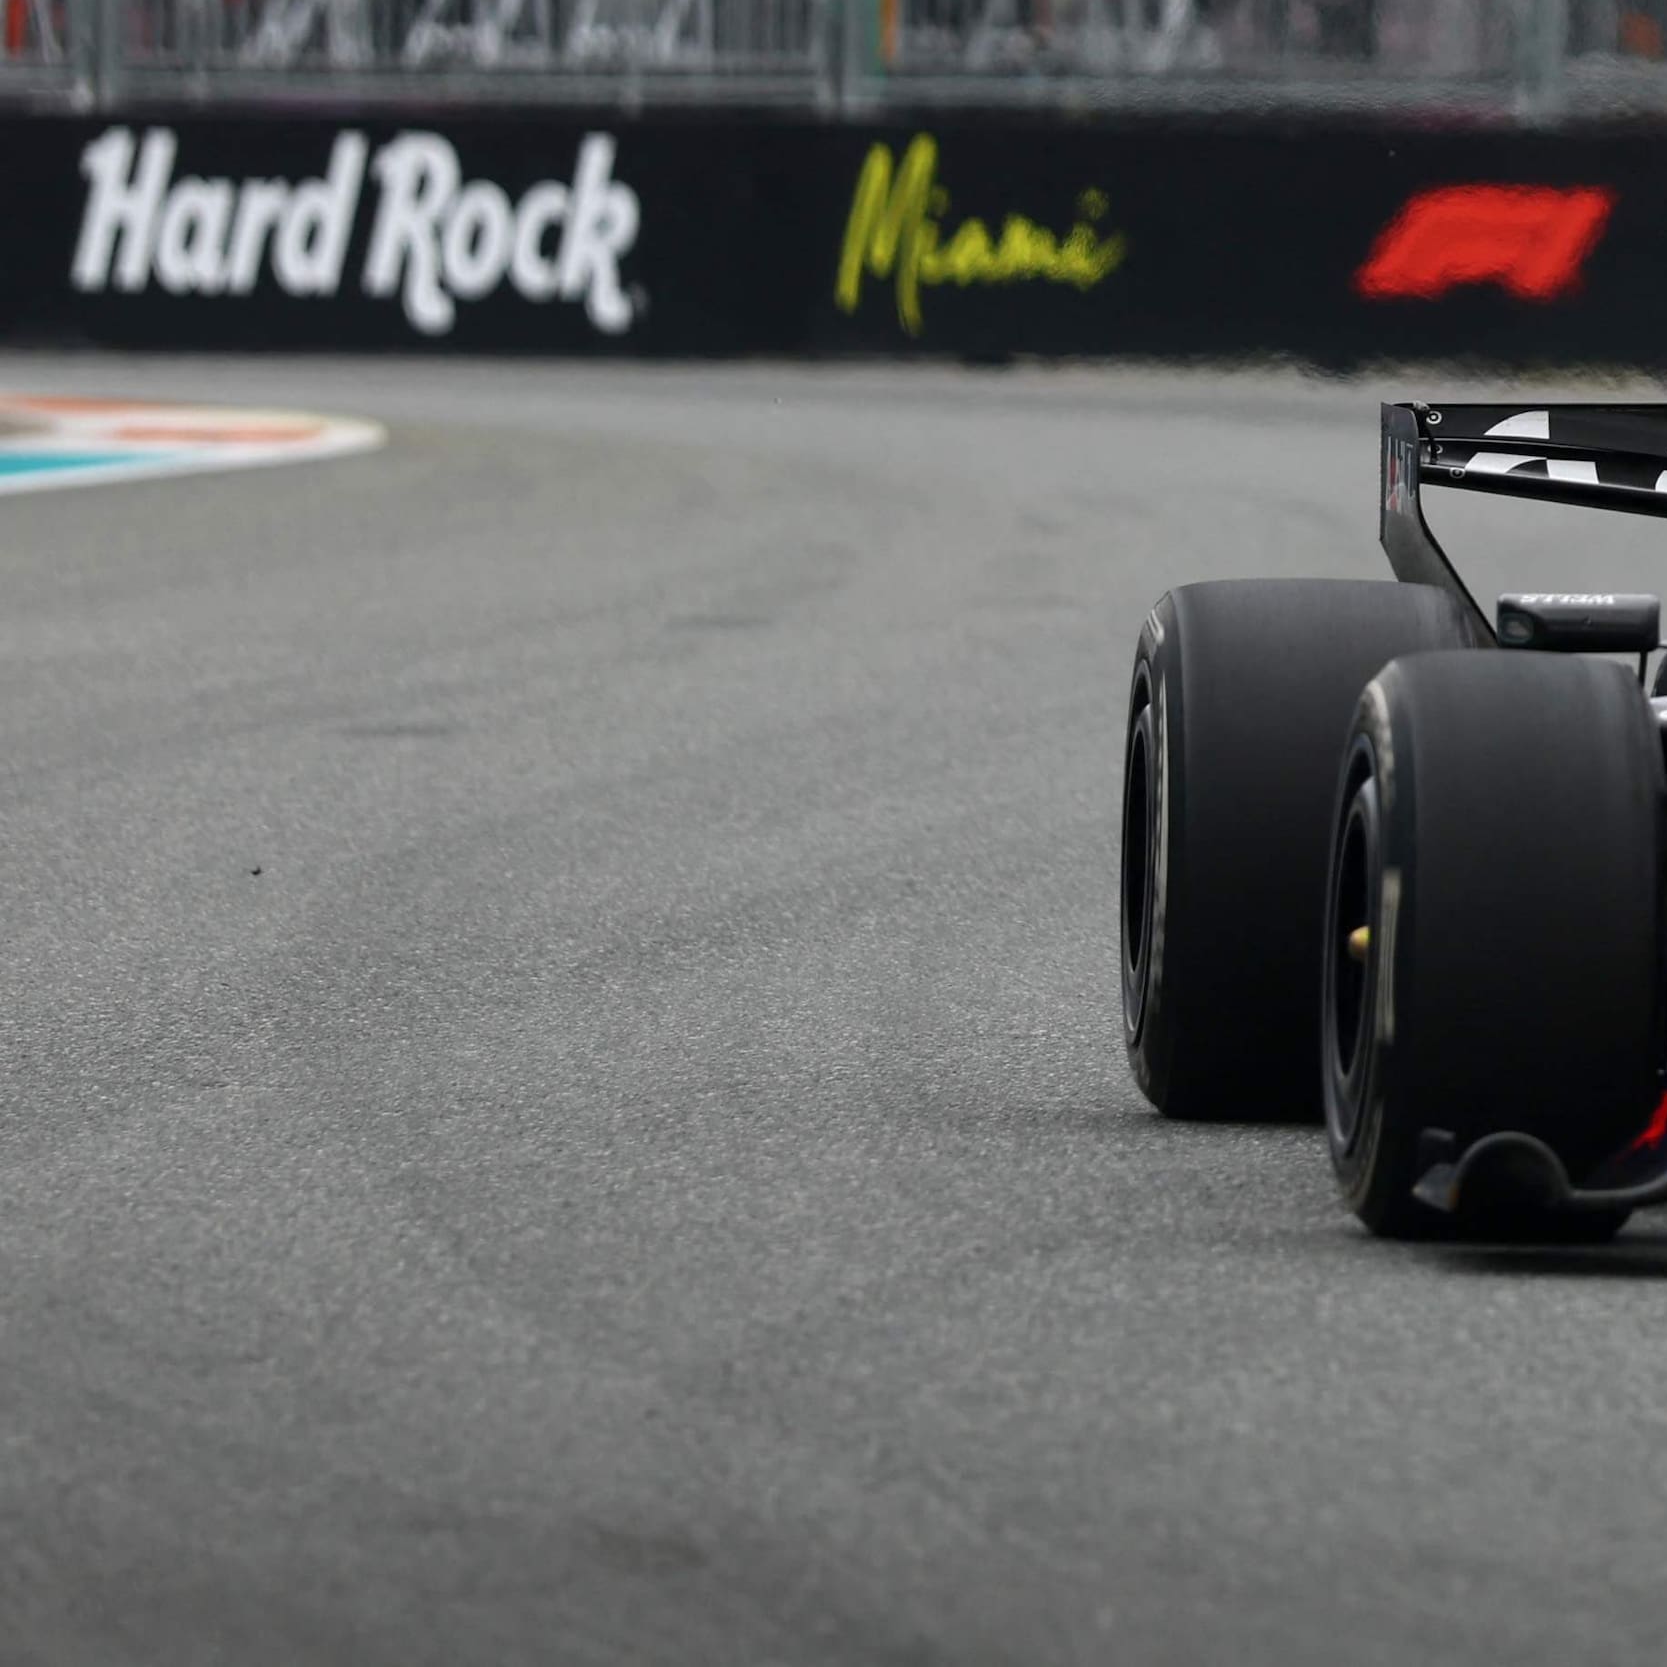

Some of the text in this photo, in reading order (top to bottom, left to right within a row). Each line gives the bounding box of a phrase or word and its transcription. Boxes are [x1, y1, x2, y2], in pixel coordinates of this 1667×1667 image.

[72, 127, 640, 331] Hard Rock
[833, 134, 1124, 331] Miami
